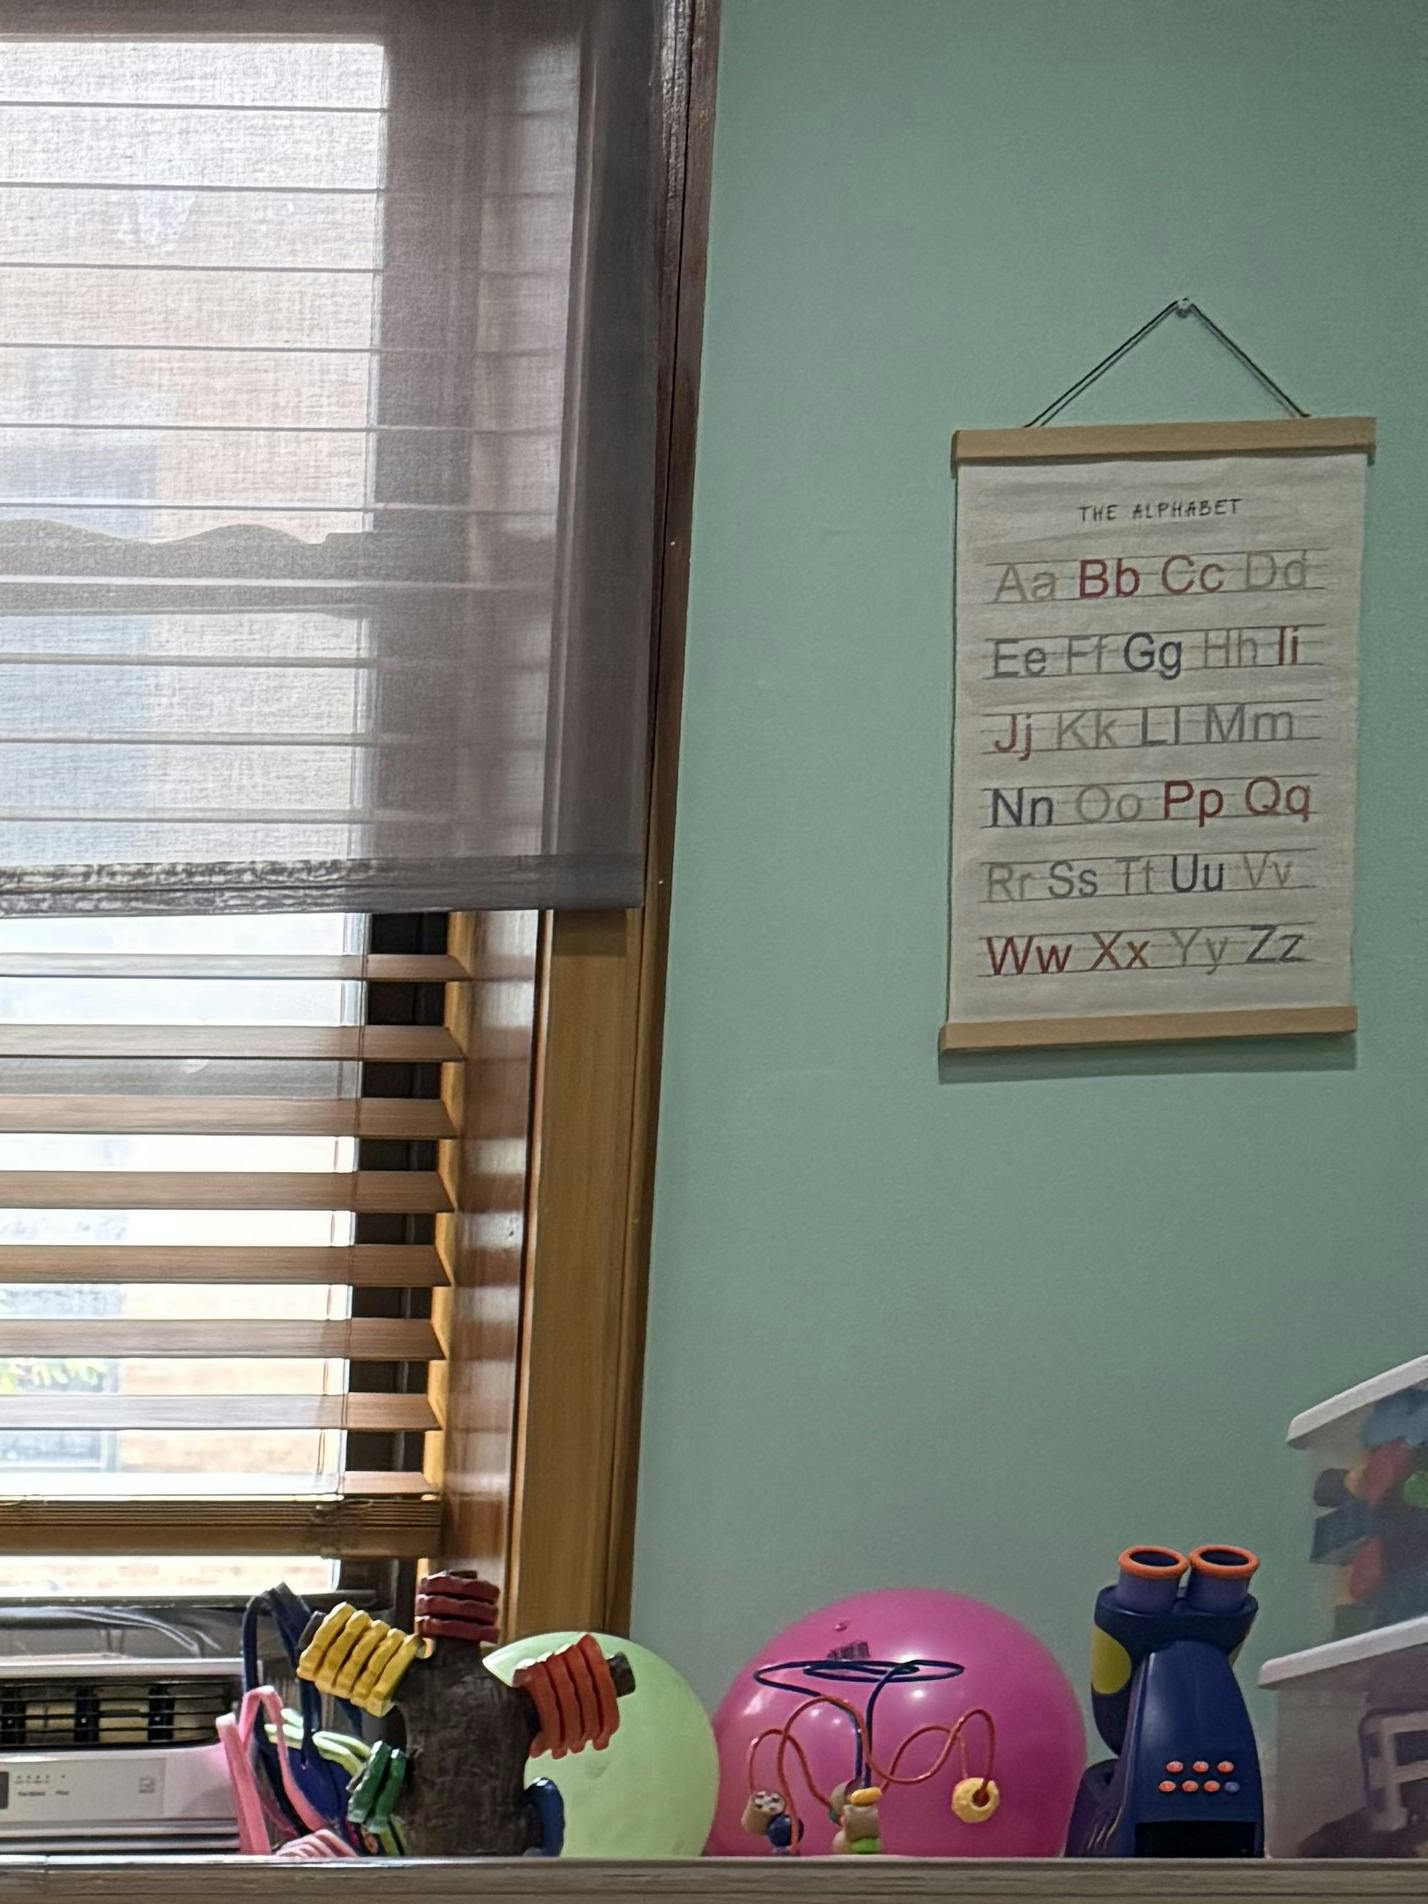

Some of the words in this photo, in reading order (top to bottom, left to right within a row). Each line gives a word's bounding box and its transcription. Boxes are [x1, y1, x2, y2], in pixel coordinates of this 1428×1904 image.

[1079, 504, 1119, 522] THE
[1132, 498, 1244, 520] ALPHABET
[995, 563, 1057, 602] Aa
[1079, 558, 1141, 600] Bb
[1161, 553, 1225, 595] Cc
[1244, 549, 1308, 592] Dd
[993, 638, 1046, 679] Ee
[1065, 634, 1110, 675] Ff
[1123, 631, 1182, 681] Gg
[1204, 628, 1259, 668] Hh
[994, 712, 1033, 762] Jj
[1056, 710, 1119, 750] Kk
[1206, 702, 1294, 744] Mm
[992, 786, 1054, 828] Nn
[1075, 784, 1142, 824] Oo
[1163, 779, 1225, 828] Pp
[1244, 775, 1312, 823] Qq
[986, 861, 1033, 902] Rr
[1047, 860, 1098, 899] Ss
[1114, 856, 1157, 896] Tt
[1171, 853, 1225, 893] Uu
[1244, 850, 1292, 889] Vv
[986, 934, 1073, 976] Ww
[1089, 930, 1151, 972] Xx
[1169, 927, 1229, 976] Yy
[1244, 924, 1312, 964] Zz
